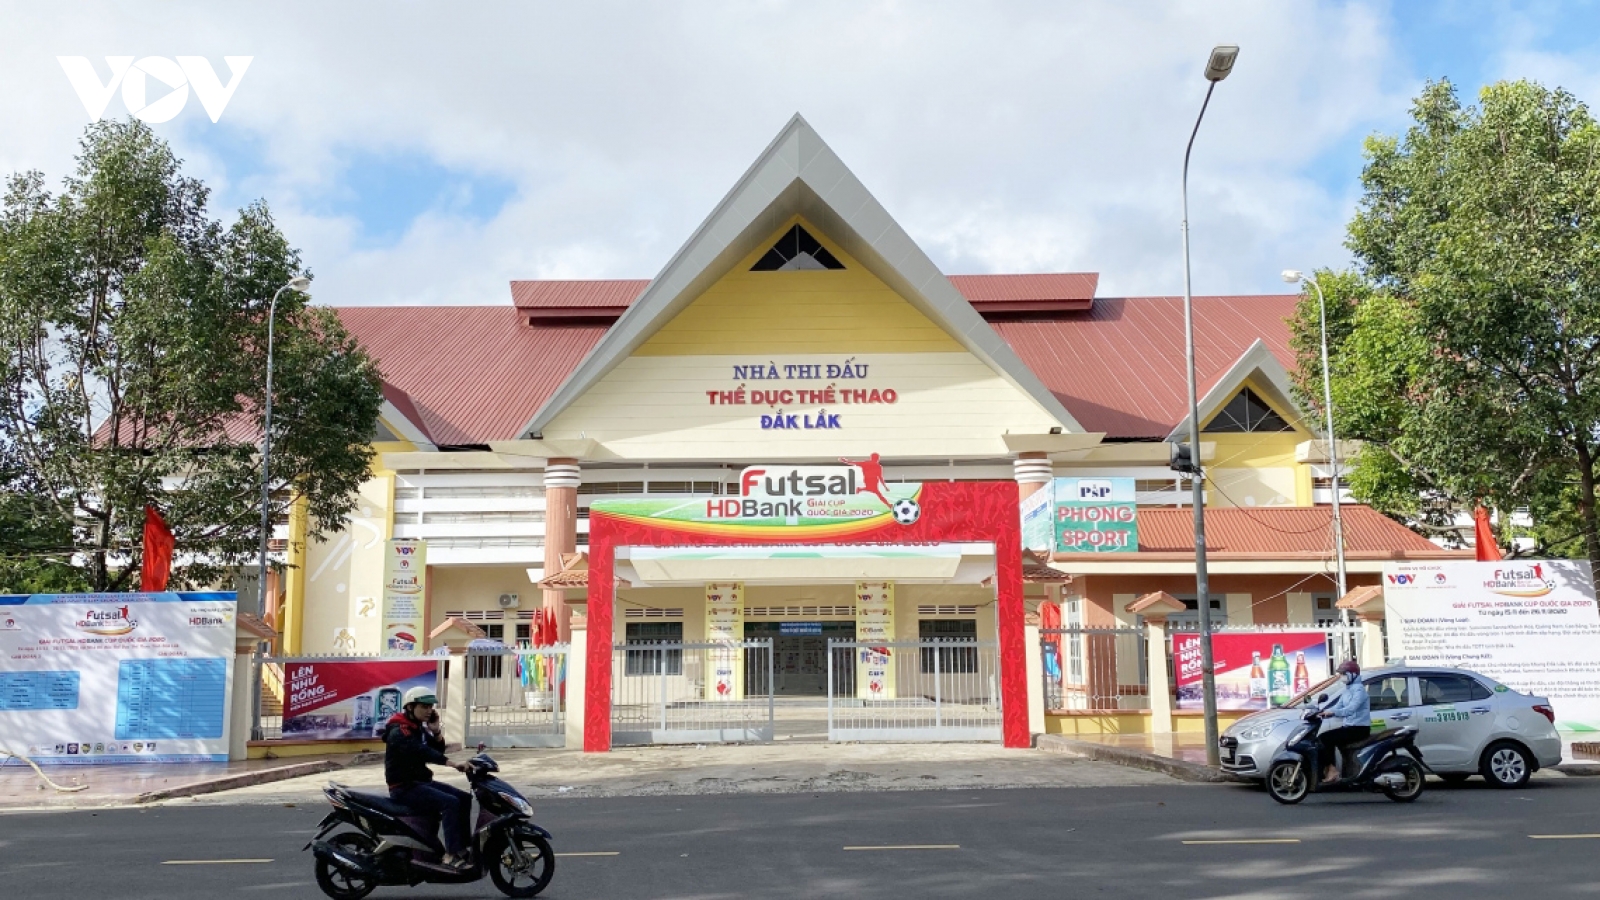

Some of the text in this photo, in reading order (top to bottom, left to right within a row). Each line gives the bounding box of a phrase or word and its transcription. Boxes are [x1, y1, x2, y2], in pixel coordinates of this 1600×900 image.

[733, 357, 869, 379] NHÀ THI ĐẤU
[706, 382, 898, 408] THỂ DỤC THỂ THAO
[761, 408, 841, 429] ĐẮK LẮK
[742, 469, 856, 496] Futsal
[706, 499, 803, 518] HDBank
[828, 499, 845, 508] CUP
[1058, 506, 1135, 522] PHONG
[1063, 530, 1128, 546] SPORT
[1388, 573, 1416, 584] VOV
[1494, 569, 1534, 580] Futsal
[1483, 580, 1517, 588] HDBank
[87, 610, 120, 620] Futsal
[189, 617, 223, 626] HDBank
[1179, 637, 1201, 651] LÊN
[291, 665, 314, 680] LÊN
[291, 674, 319, 692] NHƯ
